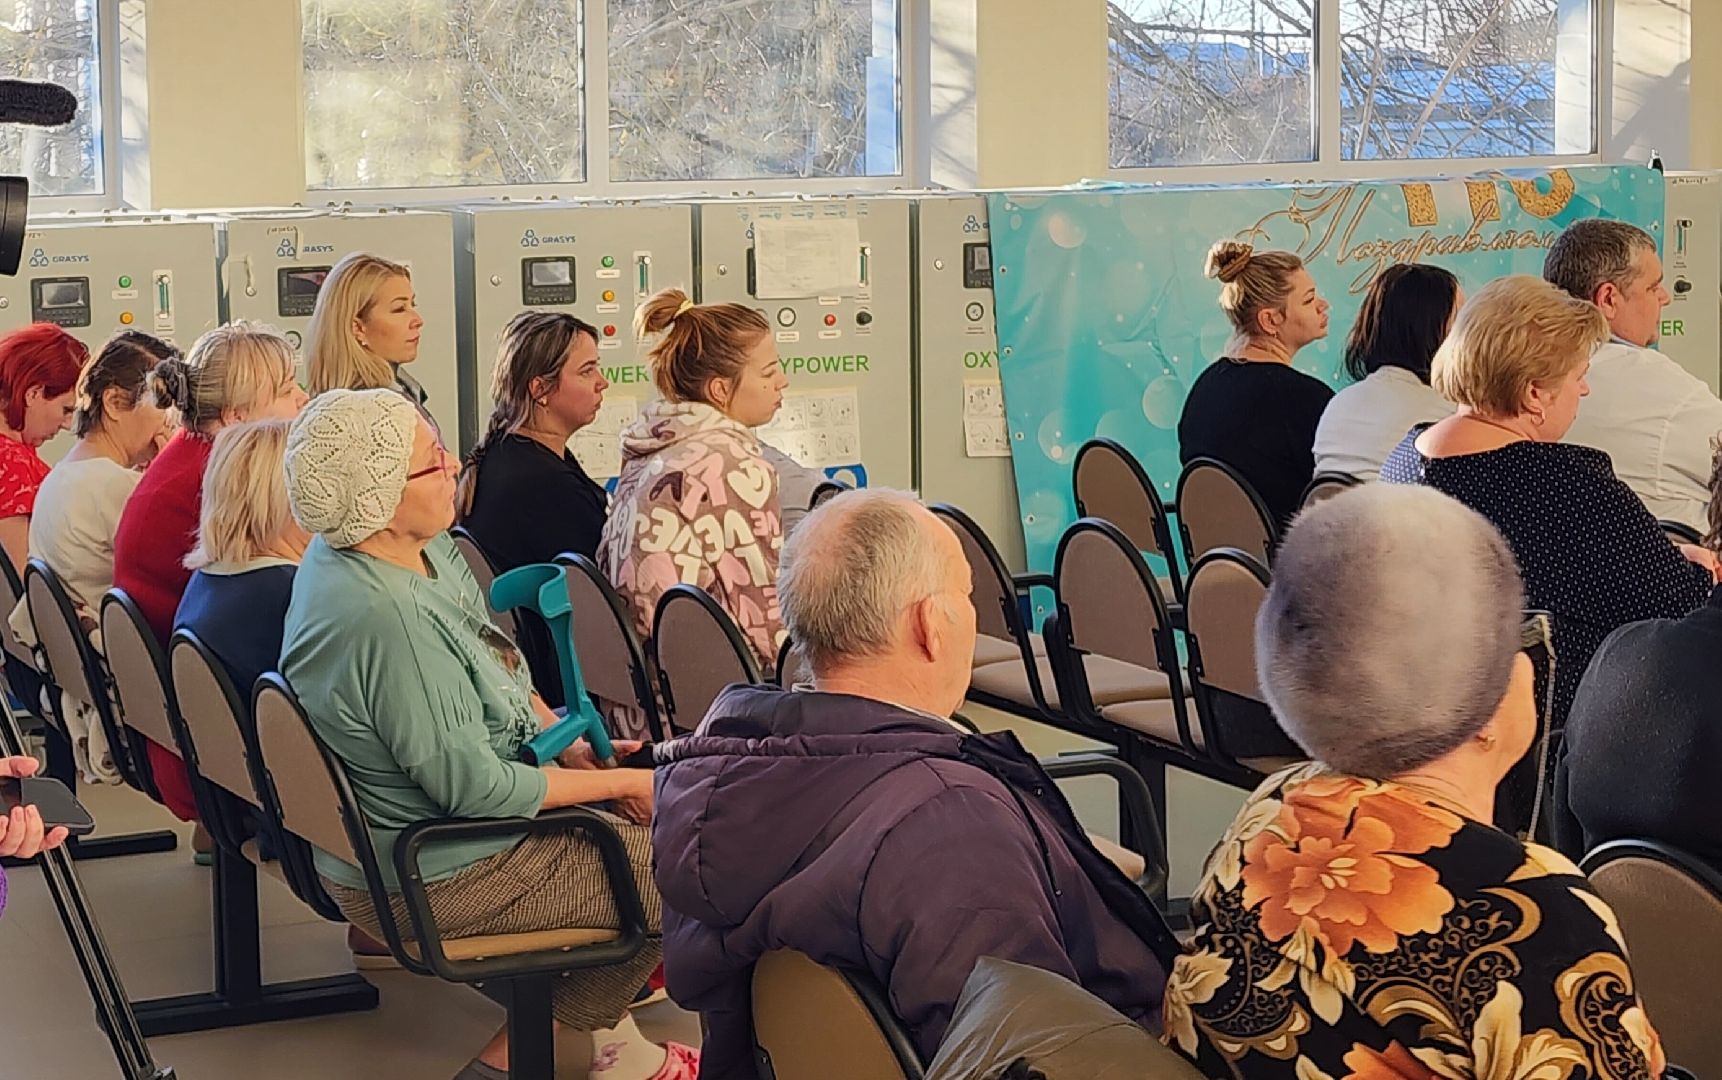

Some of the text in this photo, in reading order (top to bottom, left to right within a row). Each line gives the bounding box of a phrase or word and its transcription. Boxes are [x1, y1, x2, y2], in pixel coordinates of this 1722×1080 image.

[542, 235, 576, 244] GRASYS
[302, 245, 335, 253] RASYS
[52, 255, 90, 263] GRASYS
